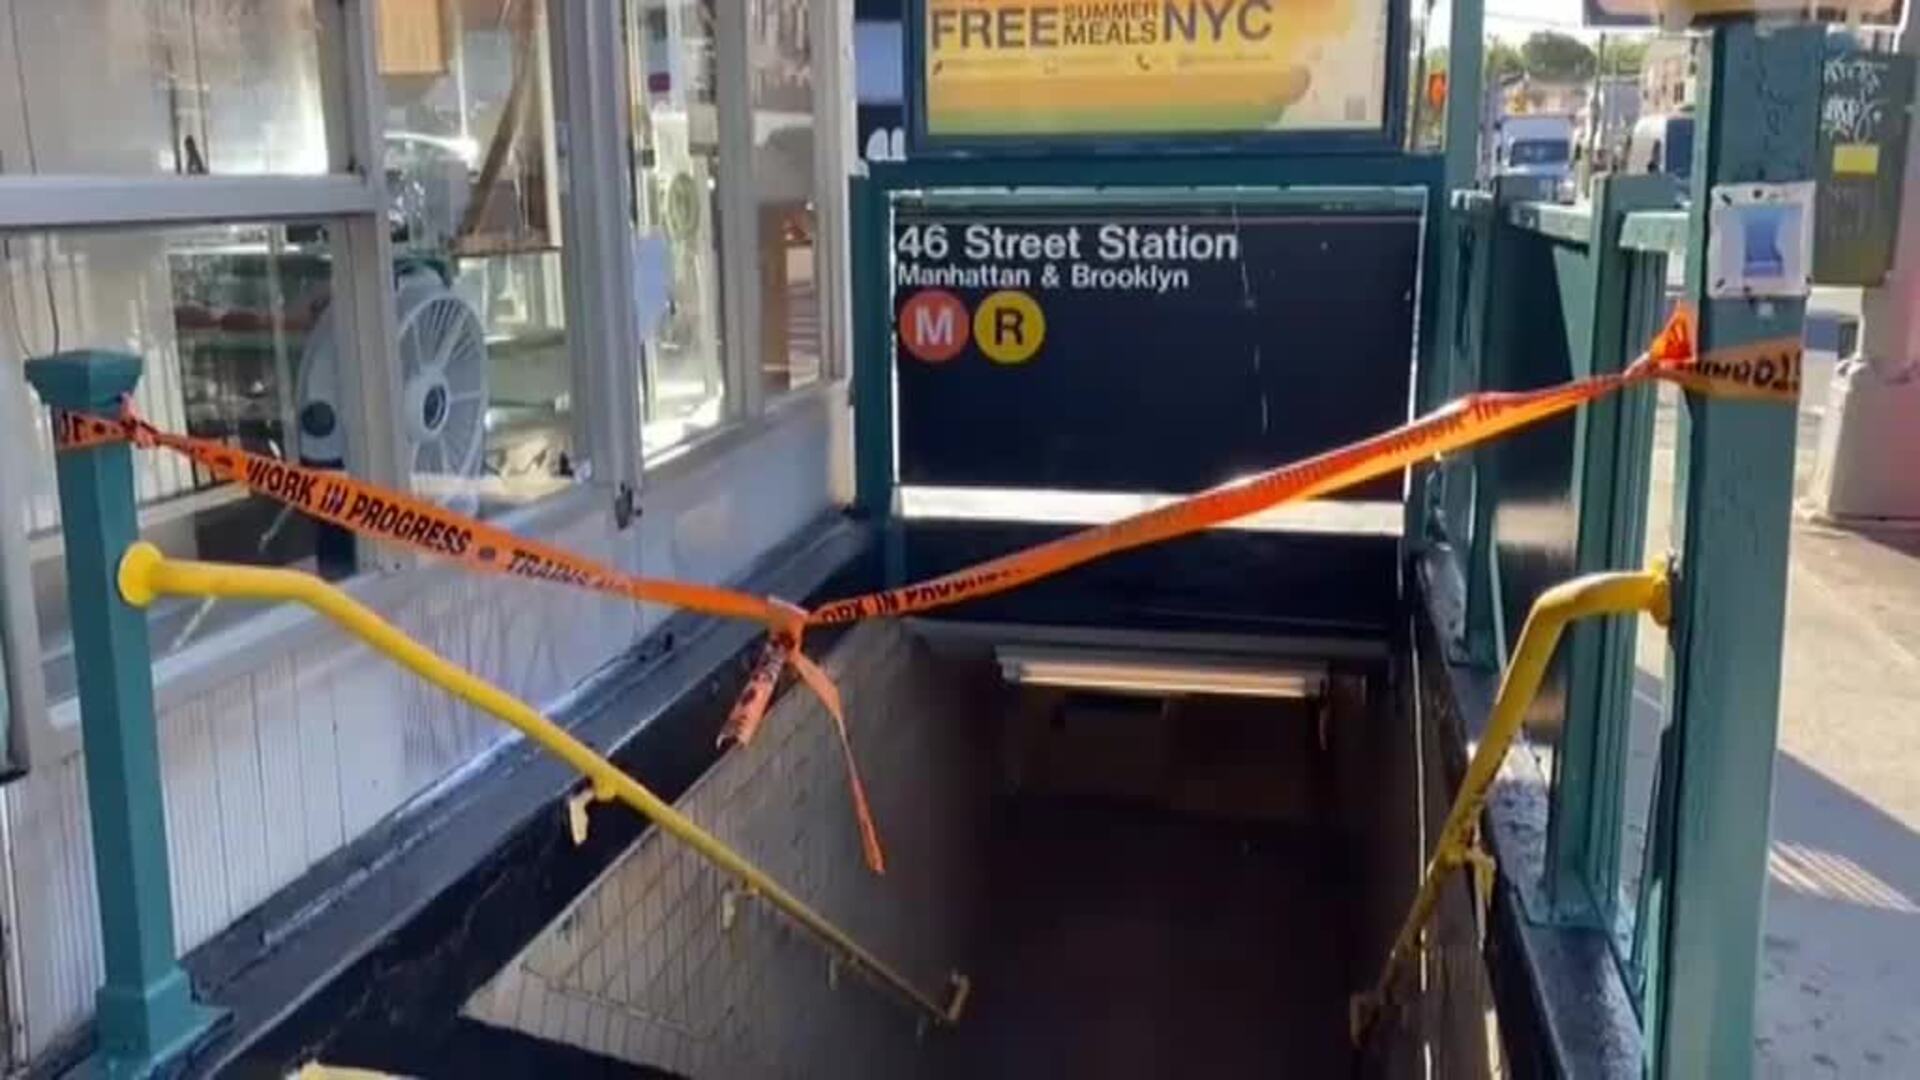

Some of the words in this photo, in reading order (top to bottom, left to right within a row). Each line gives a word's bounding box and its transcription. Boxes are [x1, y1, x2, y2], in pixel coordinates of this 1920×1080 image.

[930, 7, 1057, 49] FREE
[1162, 0, 1274, 42] NYC
[1062, 0, 1158, 22] SUMMER
[1063, 22, 1158, 46] MEALS
[898, 226, 948, 259] 46
[964, 225, 1081, 259] Street
[1098, 225, 1238, 260] Station
[898, 264, 1030, 288] Manhattan
[1041, 265, 1060, 288] &
[1072, 265, 1189, 293] Brooklyn
[914, 307, 952, 346] M
[247, 458, 316, 505] WORK
[319, 482, 349, 516] IN
[348, 494, 472, 555] PROGRESS
